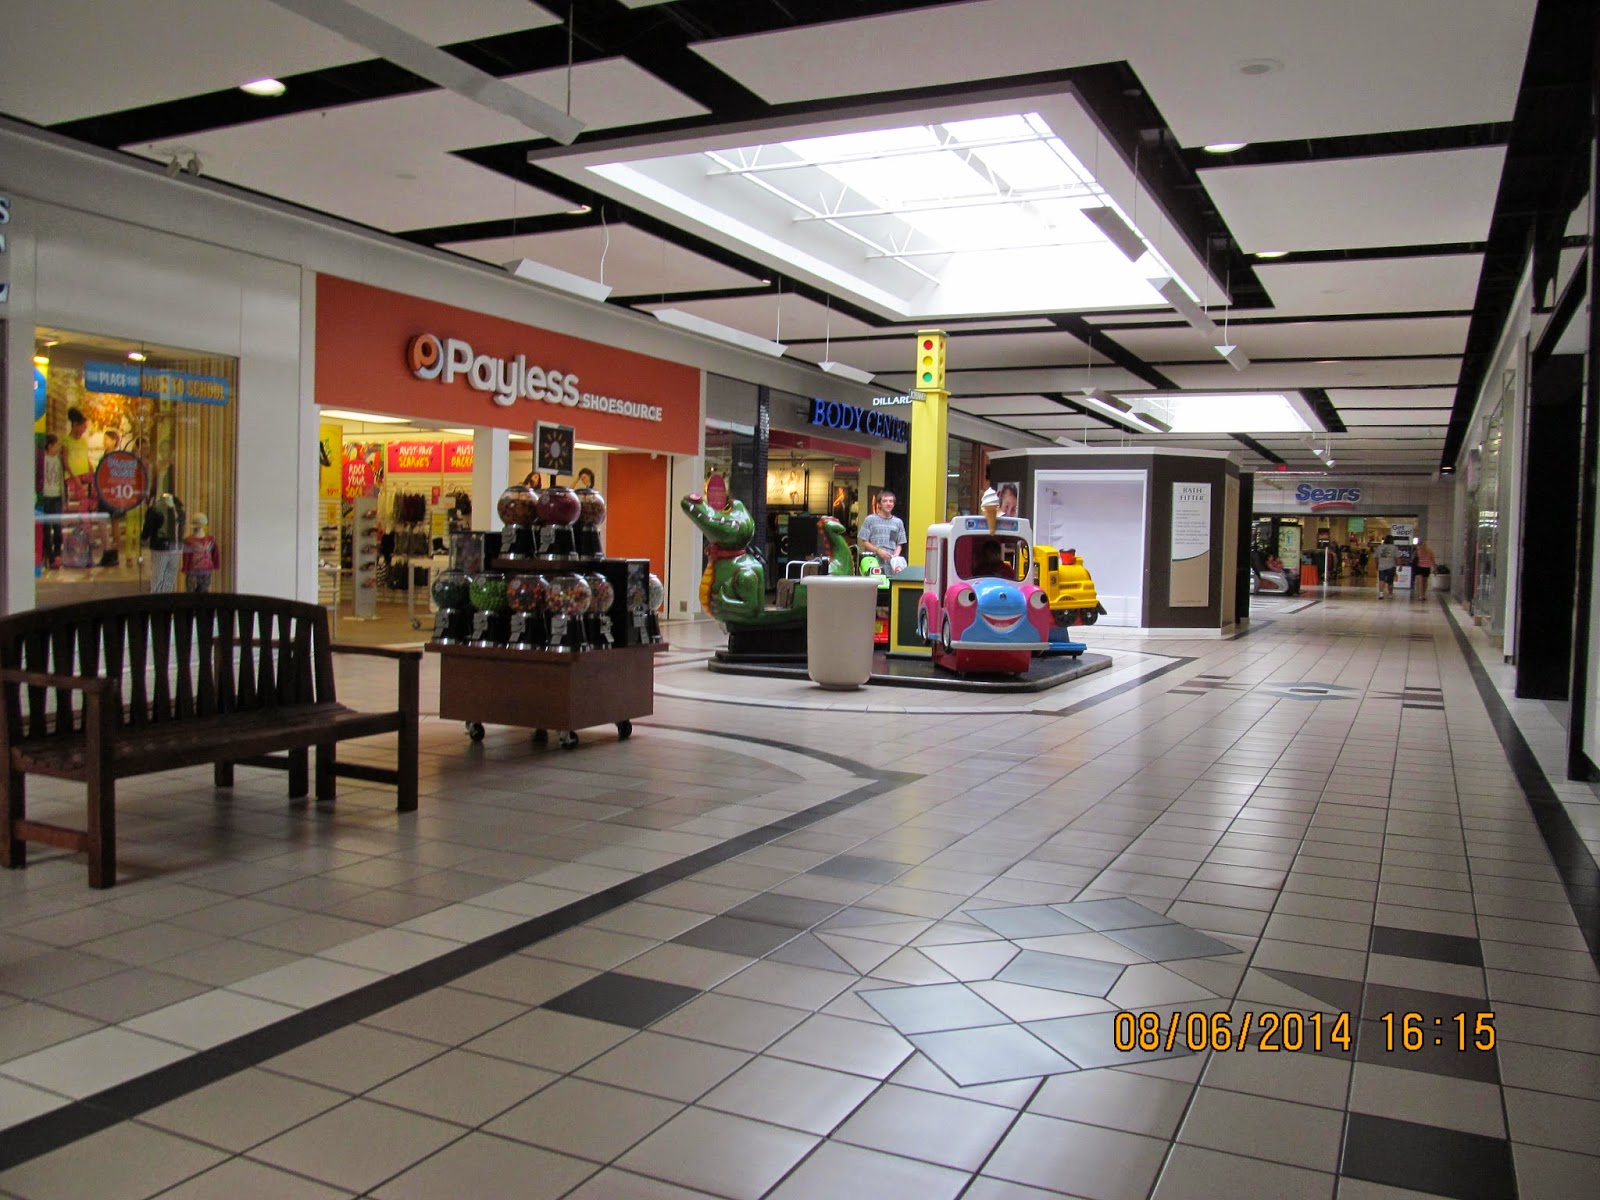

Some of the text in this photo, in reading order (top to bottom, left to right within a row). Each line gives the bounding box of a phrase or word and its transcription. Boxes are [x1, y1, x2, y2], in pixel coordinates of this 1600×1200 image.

[100, 371, 127, 387] PLACE
[172, 377, 185, 396] TO
[187, 379, 224, 401] SCHOOL
[442, 338, 579, 407] Payless
[581, 393, 662, 422] SHOESOURCE
[812, 397, 865, 433] BODY
[1295, 483, 1361, 502] Sears
